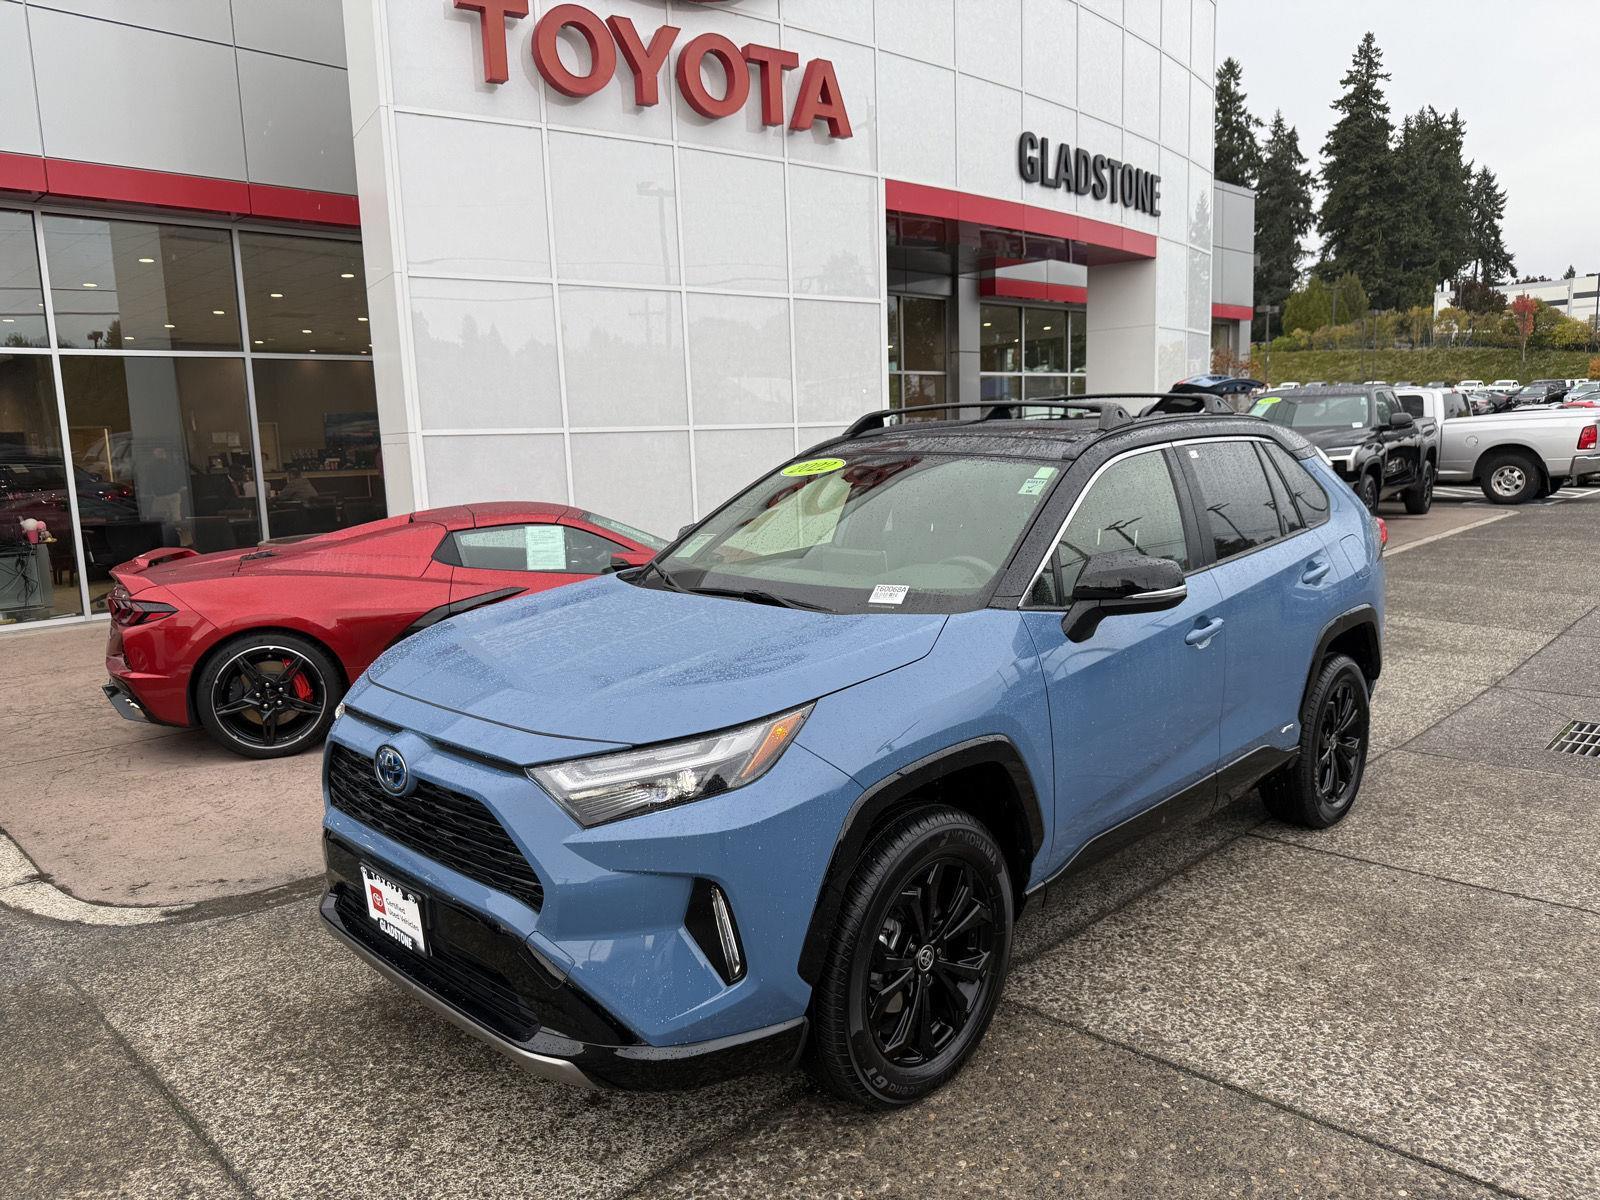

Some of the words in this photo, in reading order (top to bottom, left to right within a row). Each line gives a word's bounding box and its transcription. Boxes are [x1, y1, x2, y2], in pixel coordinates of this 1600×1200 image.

[454, 0, 853, 139] TOYOTA
[1018, 131, 1162, 217] GLADSTONE
[380, 919, 413, 951] GLADSTONE
